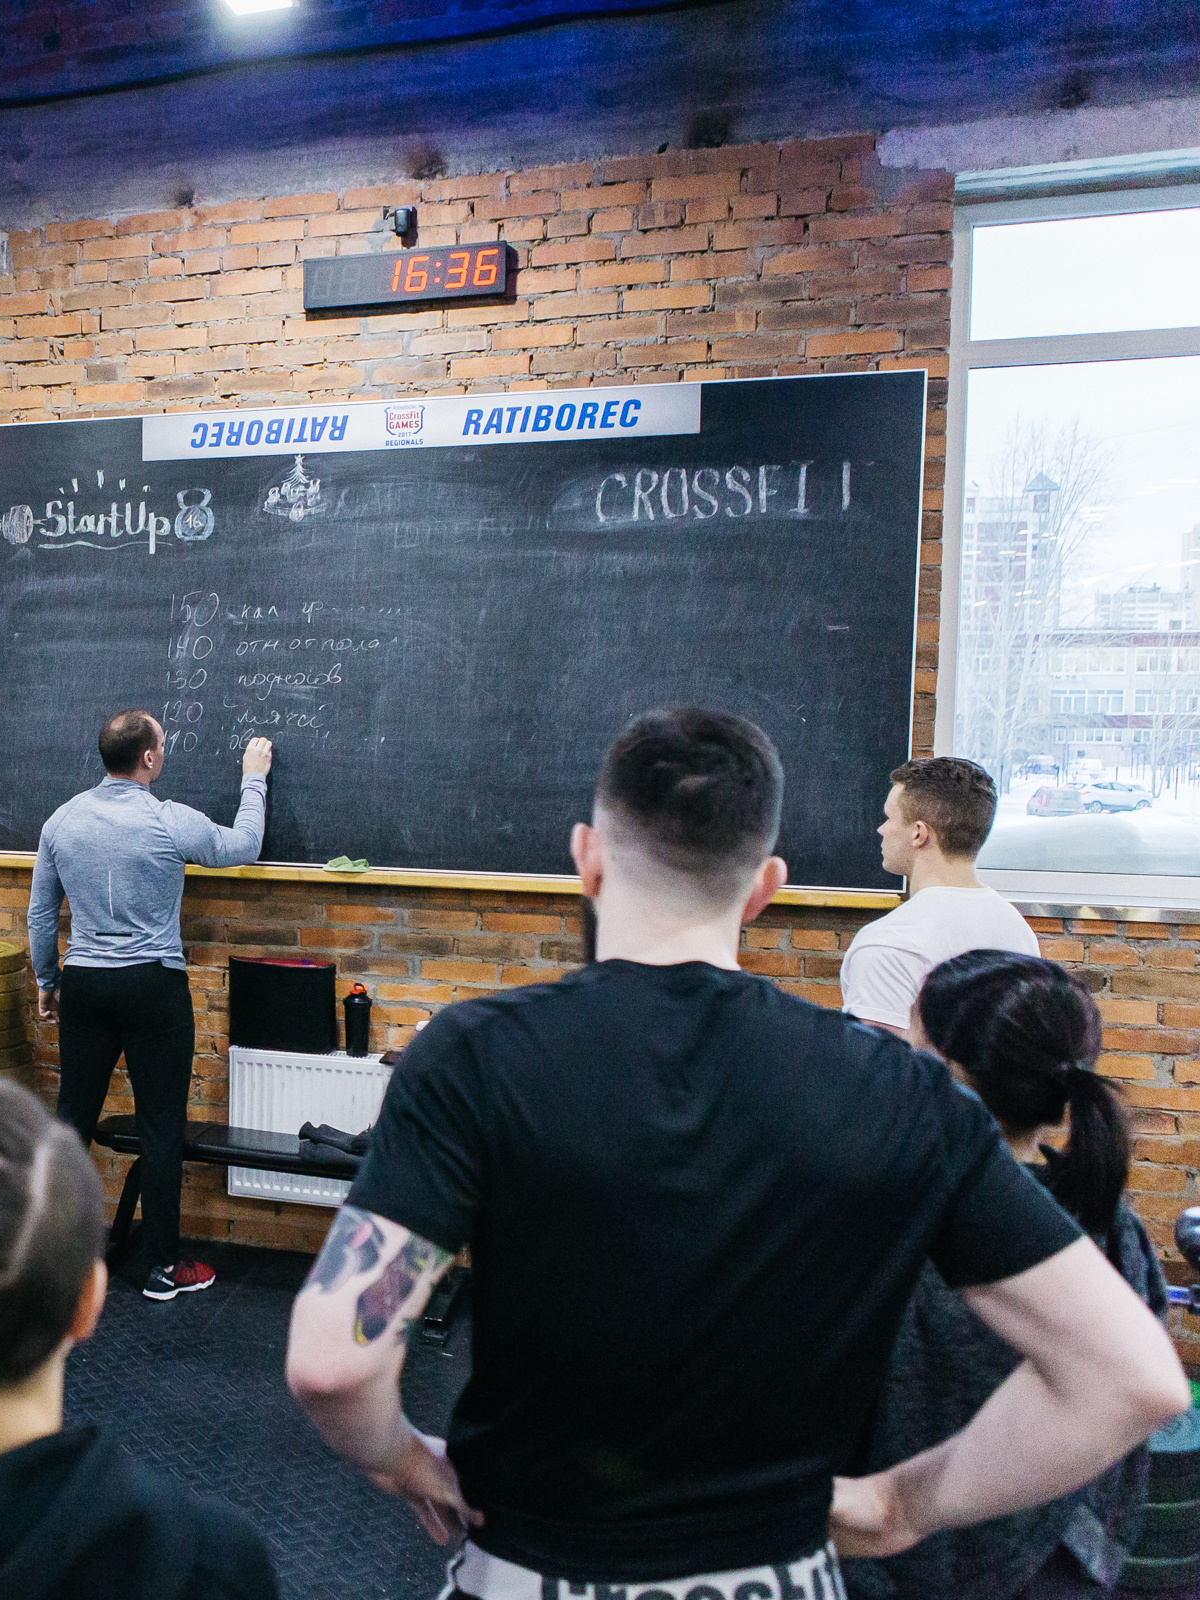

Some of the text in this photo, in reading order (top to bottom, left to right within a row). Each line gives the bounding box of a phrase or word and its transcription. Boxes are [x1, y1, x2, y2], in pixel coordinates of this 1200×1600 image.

[391, 248, 499, 293] 16:36
[190, 415, 349, 449] RATIBOREC
[389, 420, 419, 429] GAMES
[462, 400, 641, 436] RATIBOREC
[385, 438, 423, 446] REGIONALS
[170, 591, 219, 626] 150
[162, 701, 203, 723] 120
